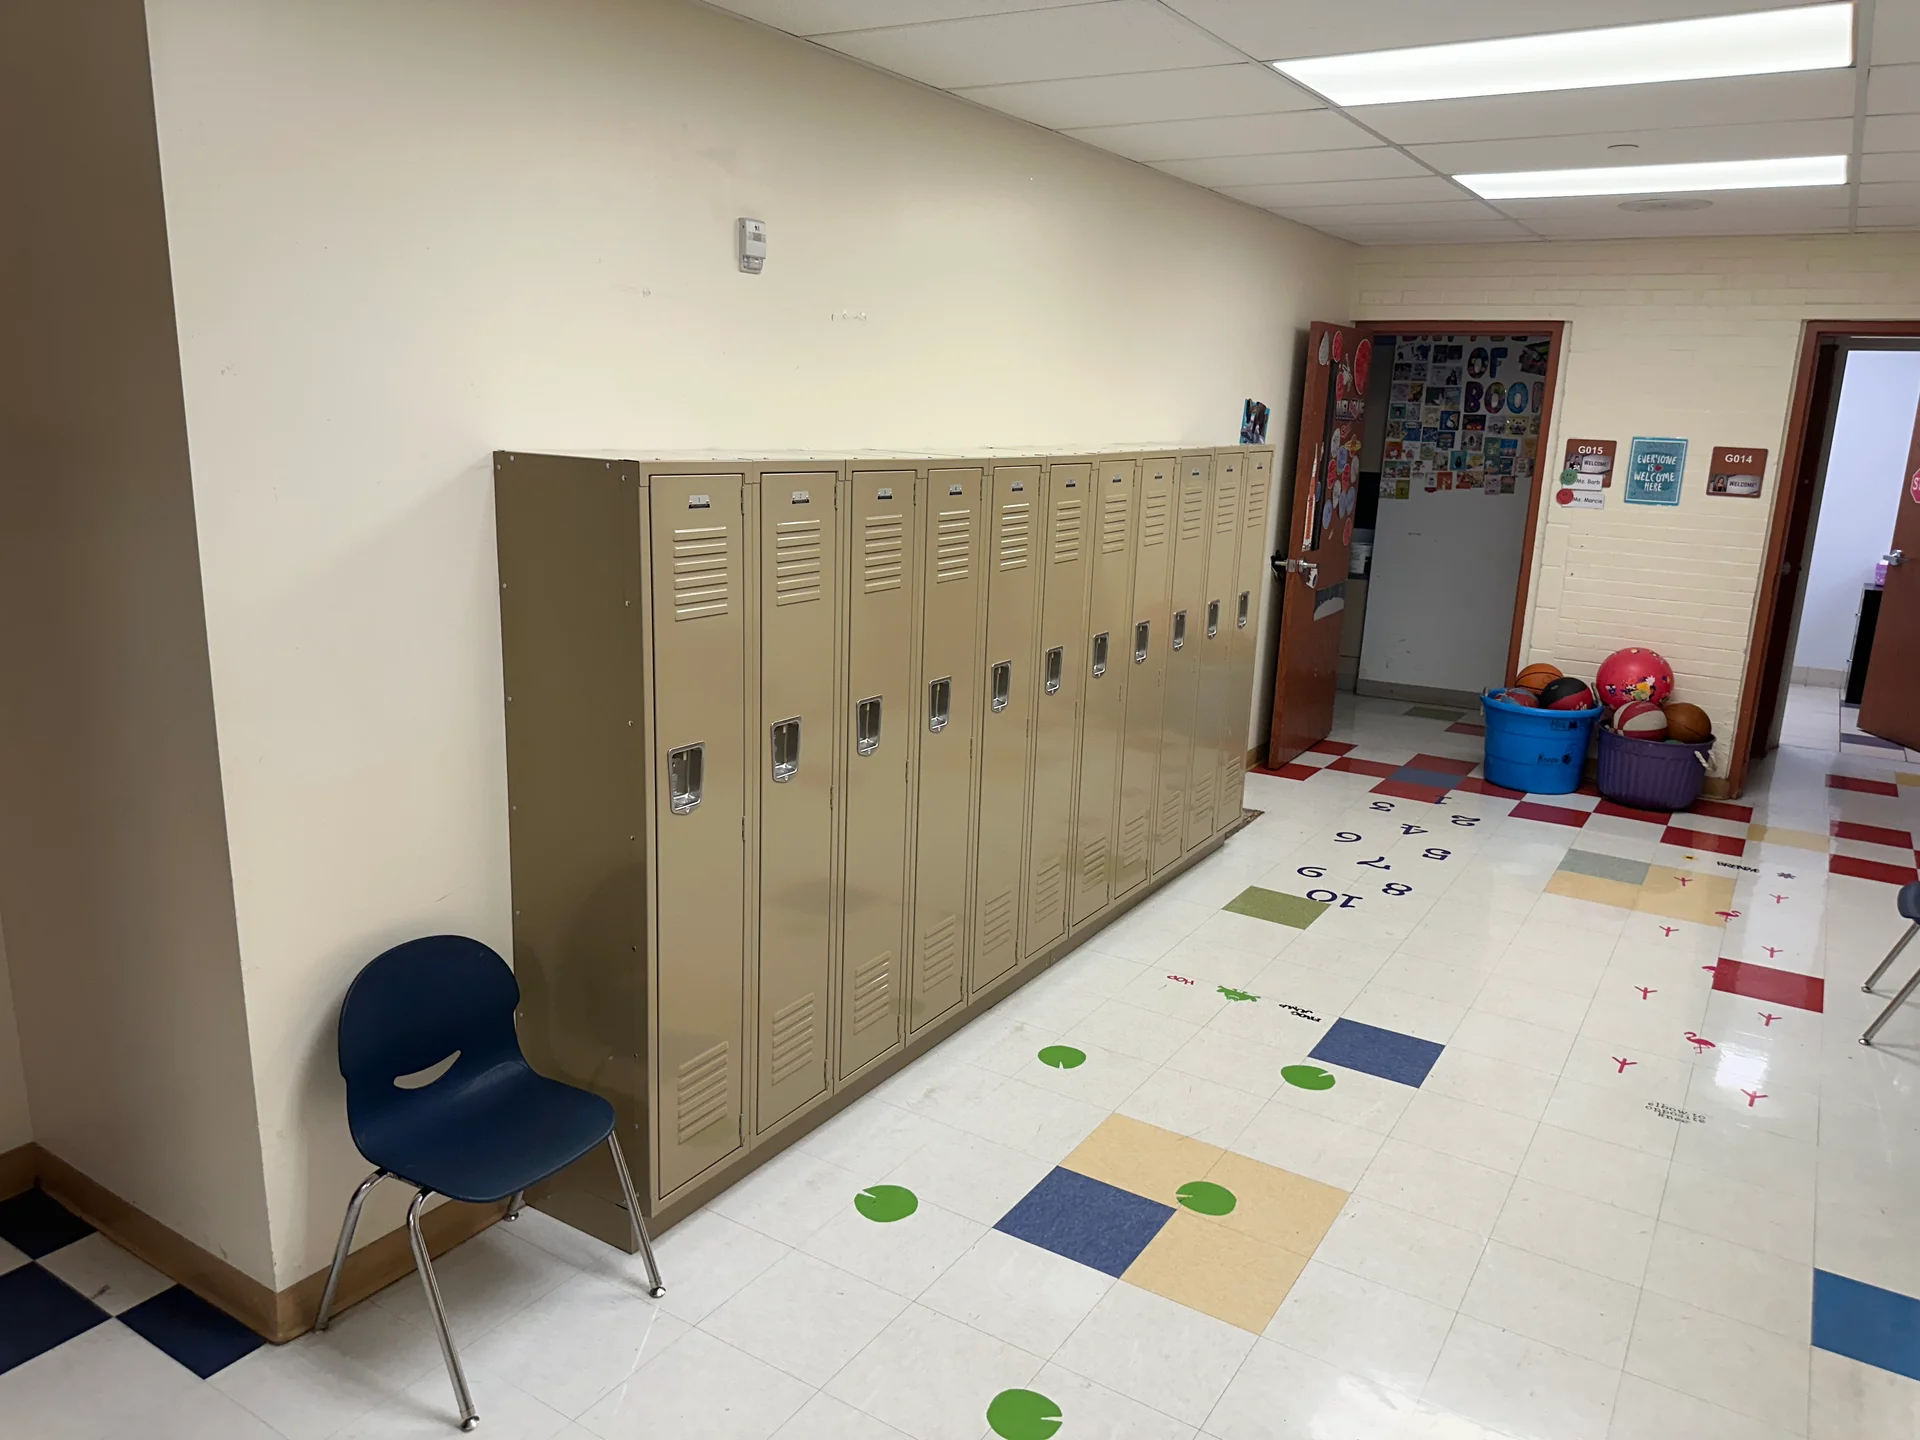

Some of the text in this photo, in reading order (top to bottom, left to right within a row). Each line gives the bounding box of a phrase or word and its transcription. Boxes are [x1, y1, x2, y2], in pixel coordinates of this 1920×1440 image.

[1467, 347, 1508, 379] OF
[1578, 446, 1603, 454] G015
[1637, 454, 1678, 465] EVERYONE
[1725, 454, 1753, 463] G014
[1634, 472, 1675, 482] WELCOME
[1644, 482, 1662, 492] HERE
[1369, 801, 1395, 812] 3
[1451, 815, 1480, 826] 2
[1400, 823, 1428, 836] 4
[1334, 832, 1362, 842] 6
[1422, 848, 1451, 861] 5
[1357, 856, 1391, 870] 7
[1297, 866, 1327, 878] 9
[1382, 882, 1412, 896] 8
[1306, 889, 1363, 908] 10
[1279, 1003, 1313, 1014] JUMP
[1647, 1102, 1688, 1114] elbow
